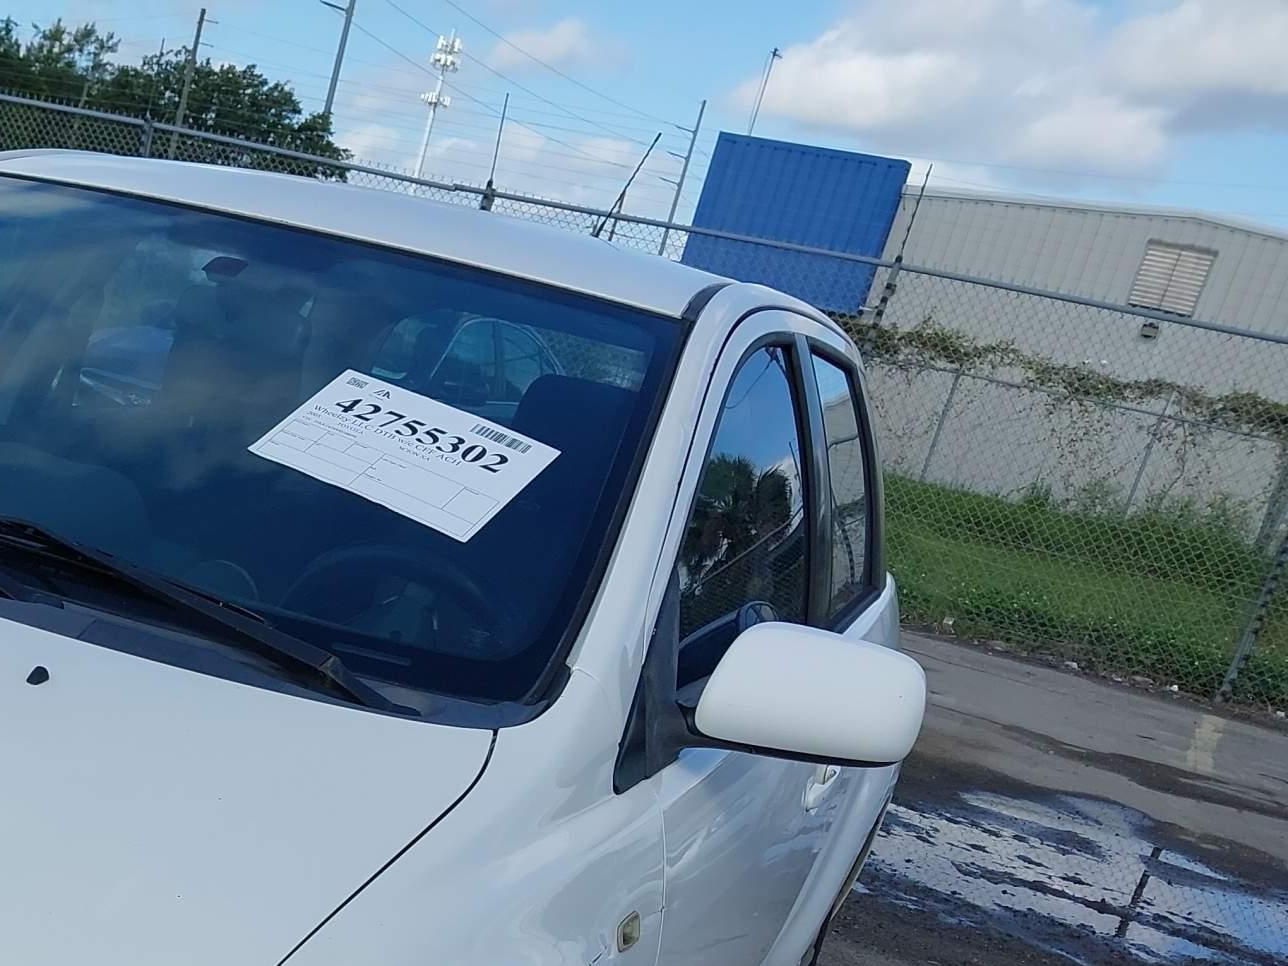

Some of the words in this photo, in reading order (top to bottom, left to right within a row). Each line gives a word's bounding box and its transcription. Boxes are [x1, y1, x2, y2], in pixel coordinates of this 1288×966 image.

[335, 398, 509, 473] 42755302
[352, 419, 373, 431] LLC
[374, 428, 396, 441] DTB
[436, 453, 463, 466] ACH
